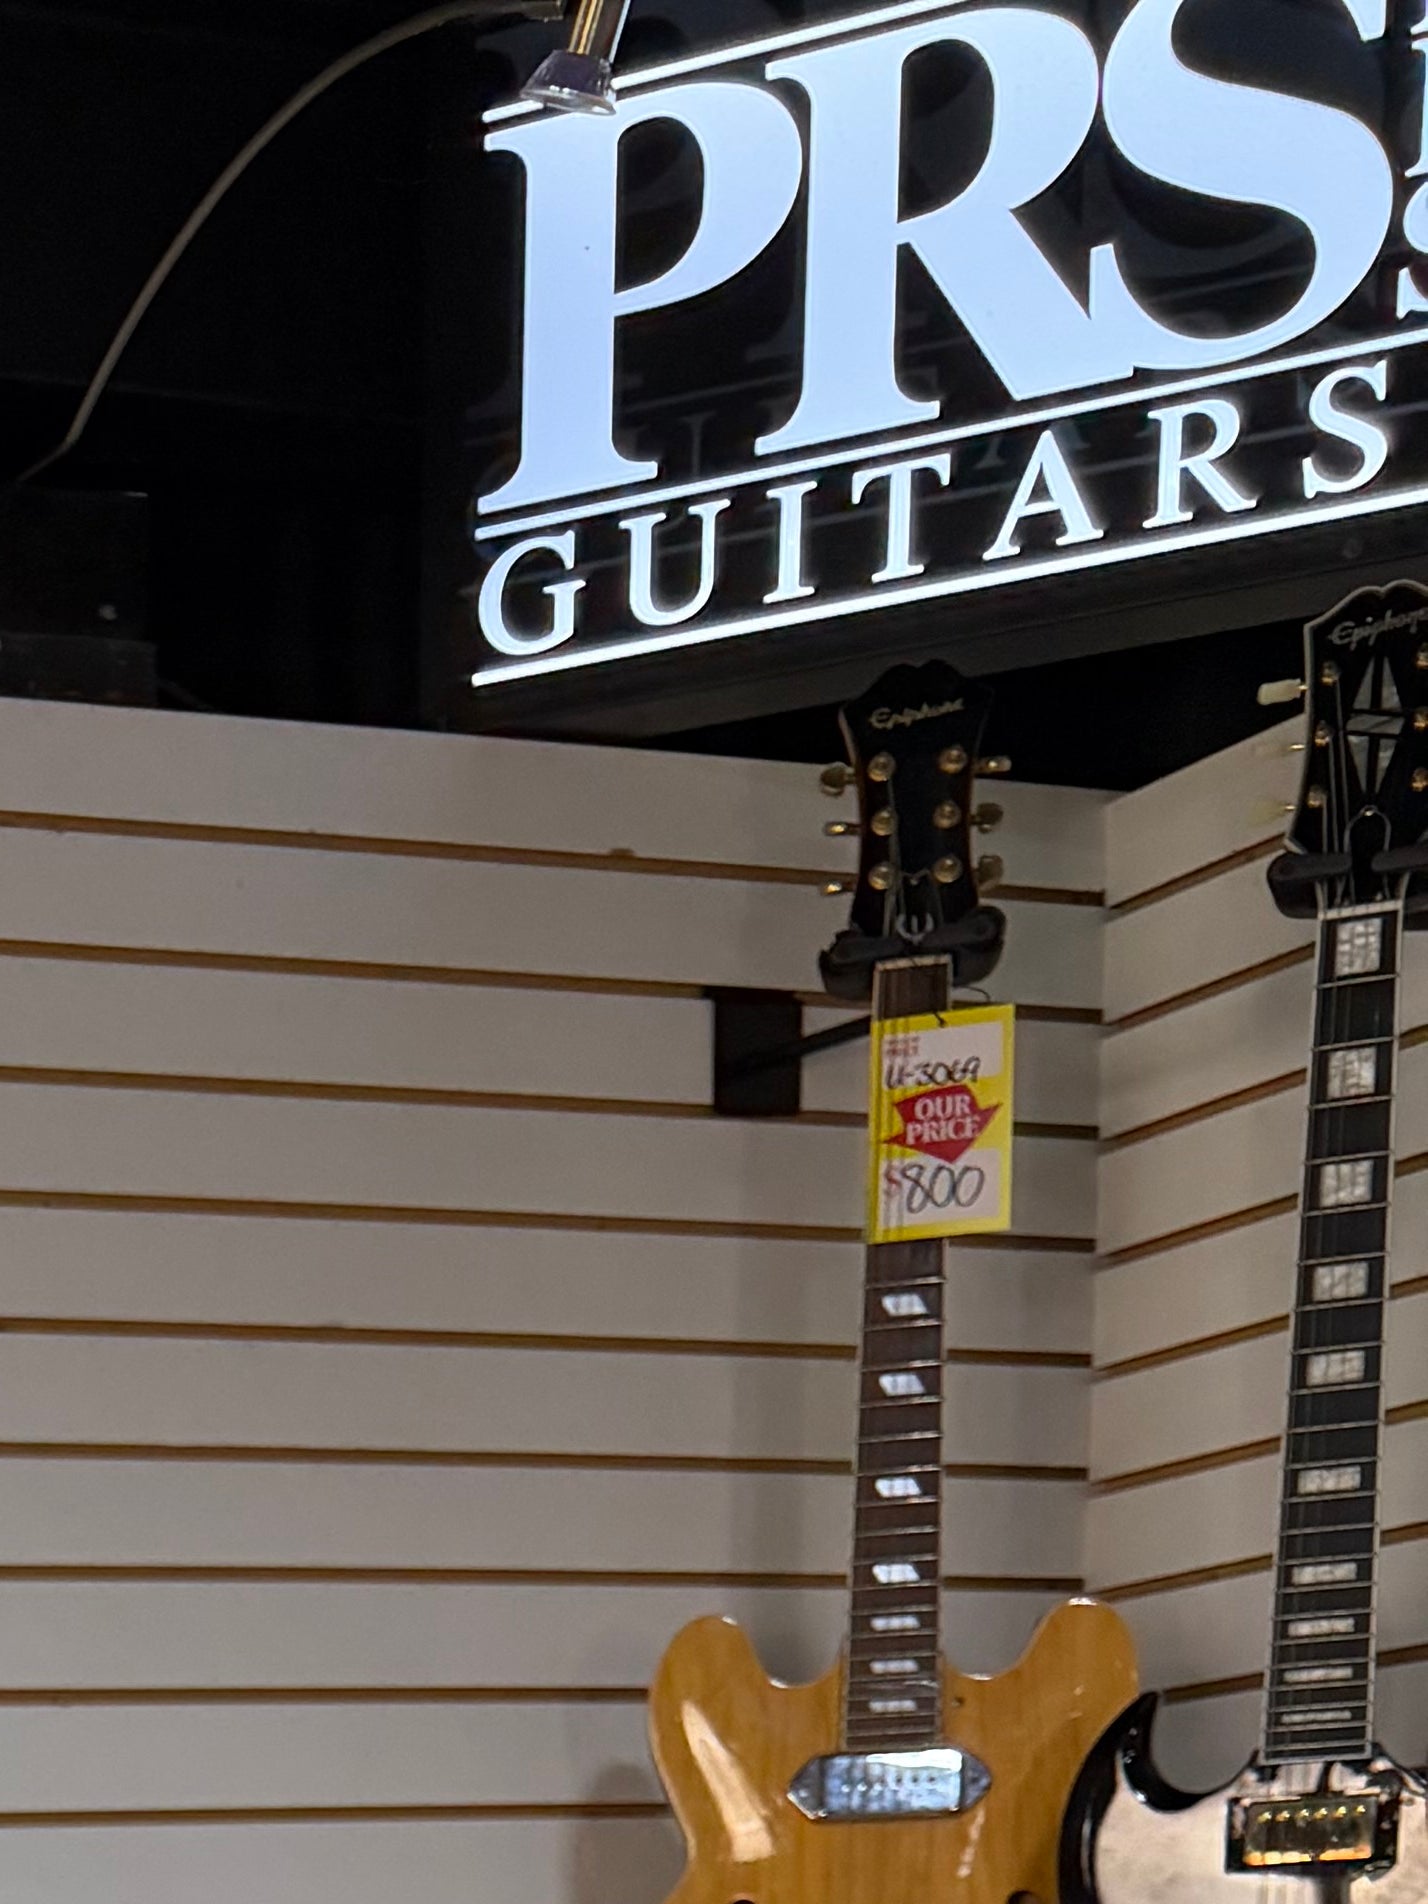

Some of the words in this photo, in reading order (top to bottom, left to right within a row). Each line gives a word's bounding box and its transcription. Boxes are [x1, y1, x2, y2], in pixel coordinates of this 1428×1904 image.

[478, 0, 1392, 515] PRS
[477, 359, 1389, 657] GUITARS
[905, 1116, 982, 1146] PRICE
[913, 1094, 972, 1122] OUR
